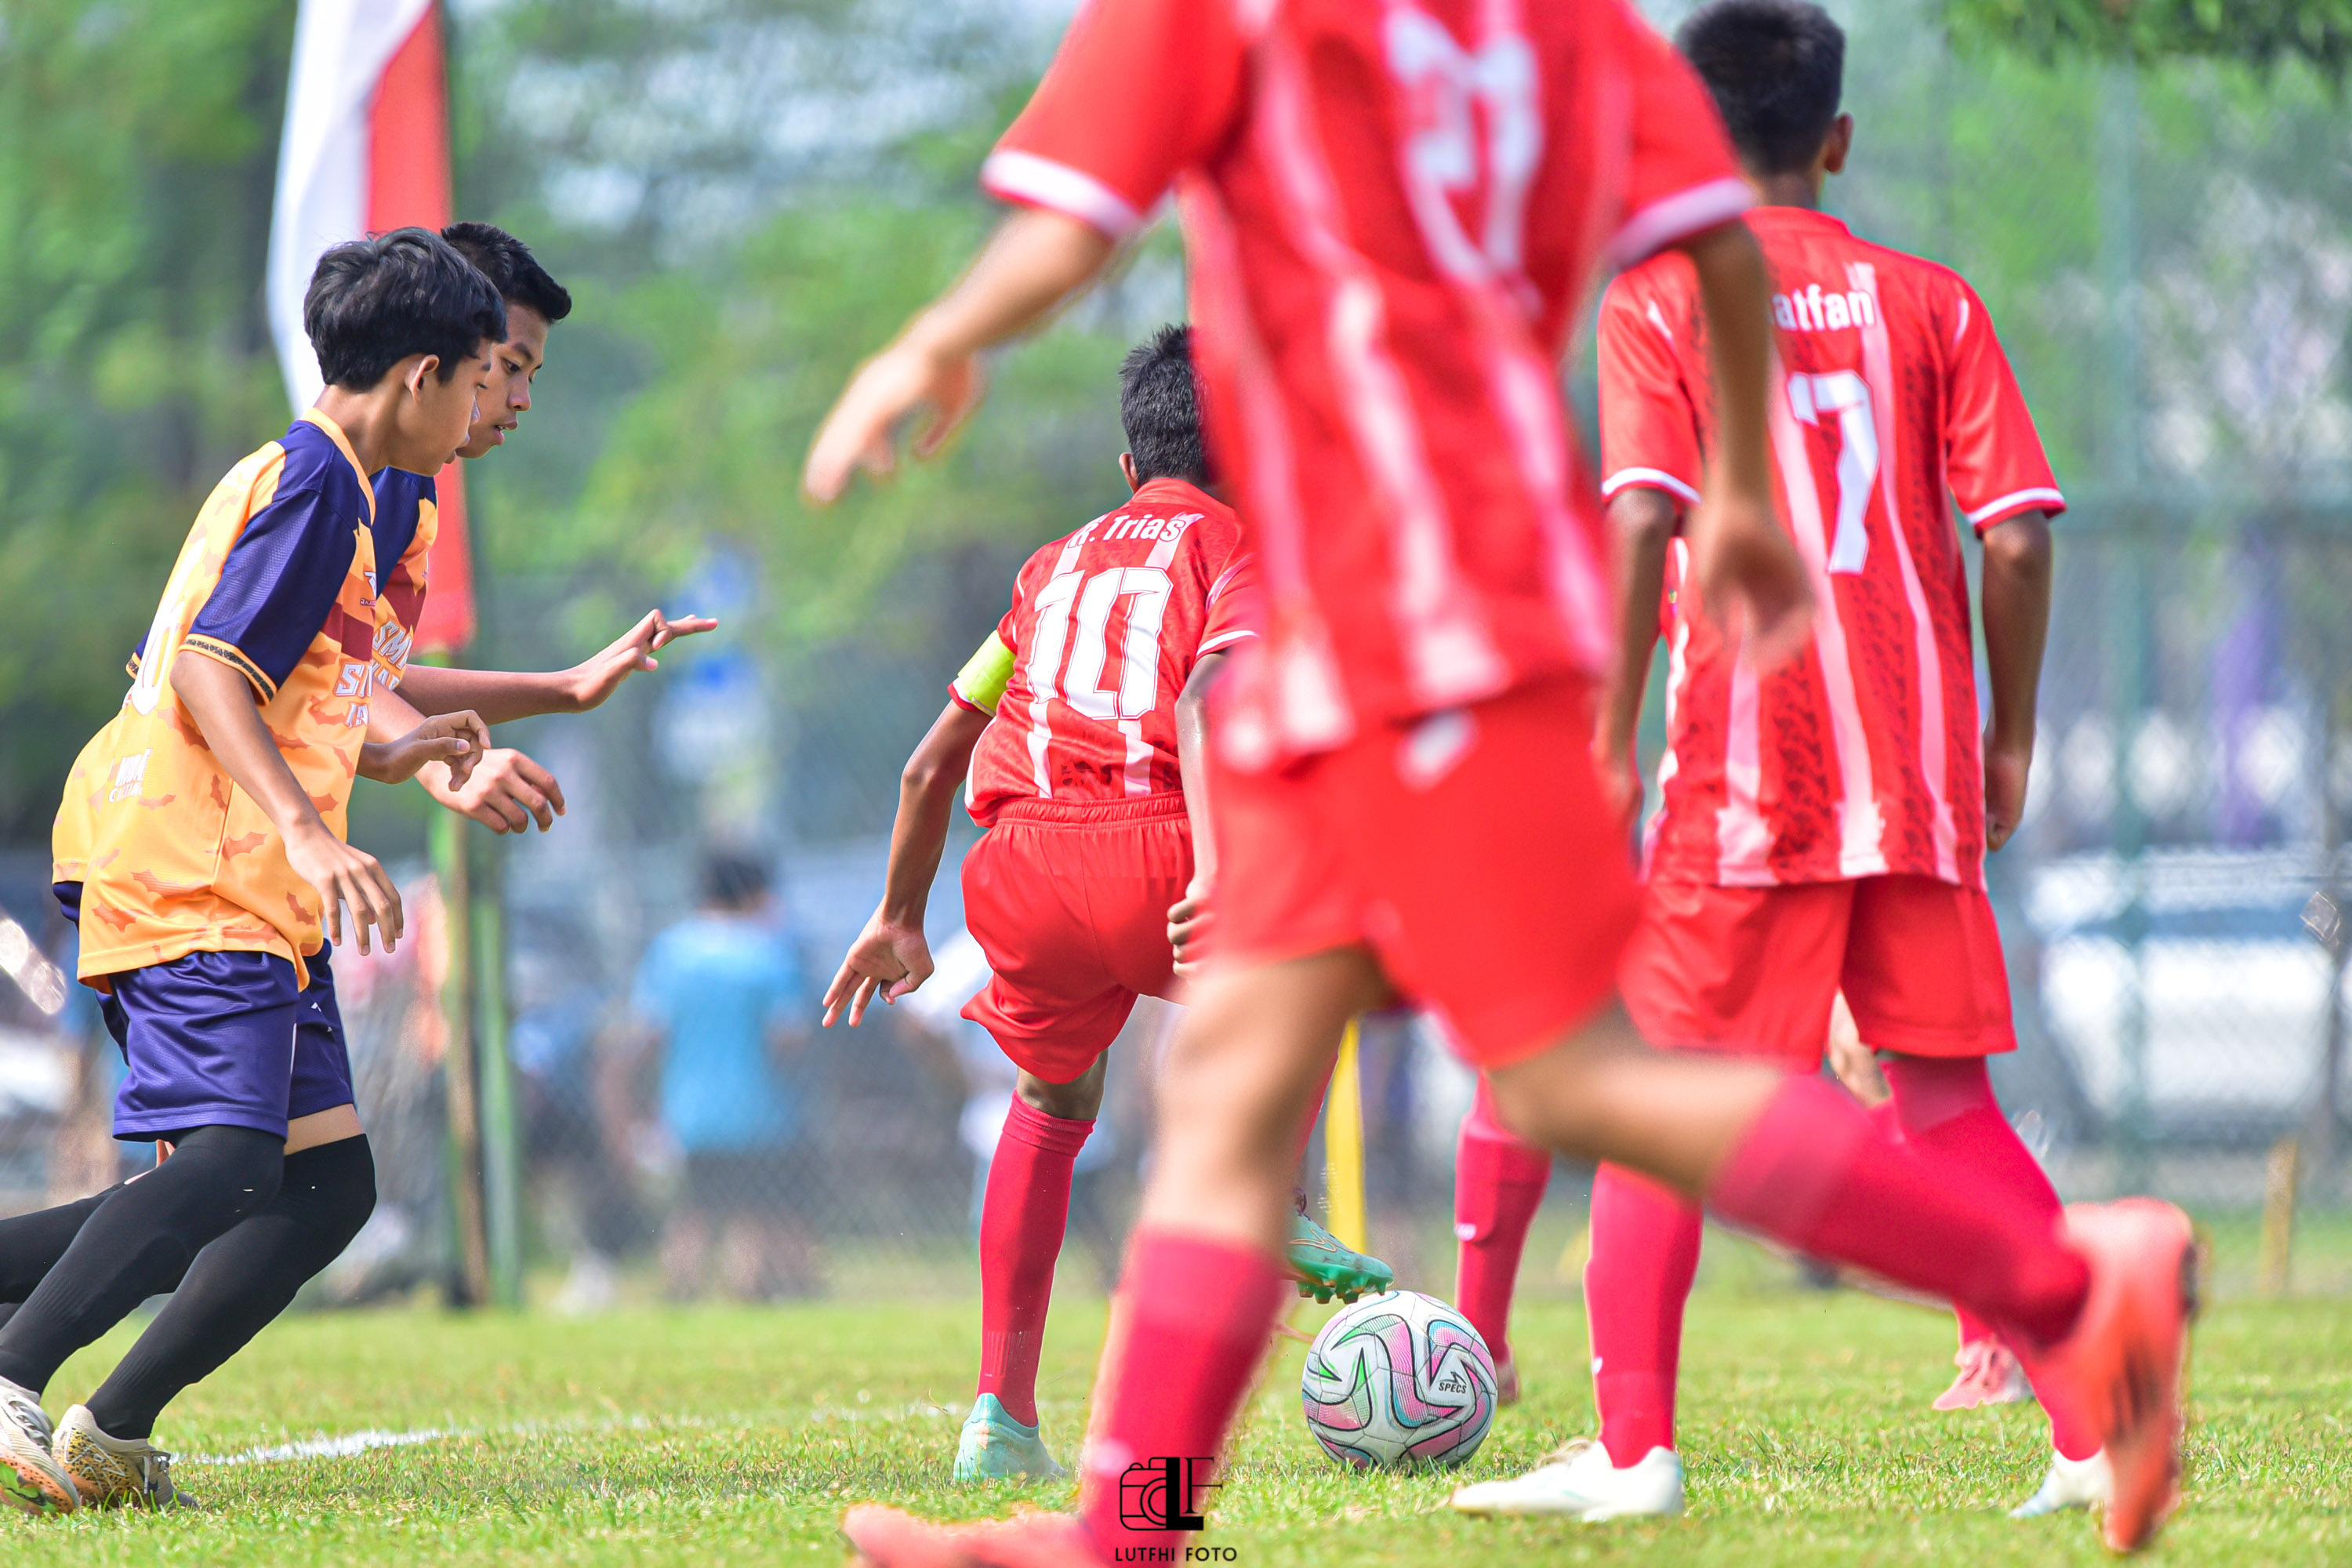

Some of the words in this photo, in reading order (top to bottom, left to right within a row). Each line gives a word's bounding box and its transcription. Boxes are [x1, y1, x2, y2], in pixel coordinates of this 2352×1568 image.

[1767, 283, 1876, 332] atfan
[1787, 369, 1881, 575] 7
[1102, 514, 1186, 543] Trias
[1026, 566, 1174, 720] 10
[1438, 1381, 1467, 1394] SPECS
